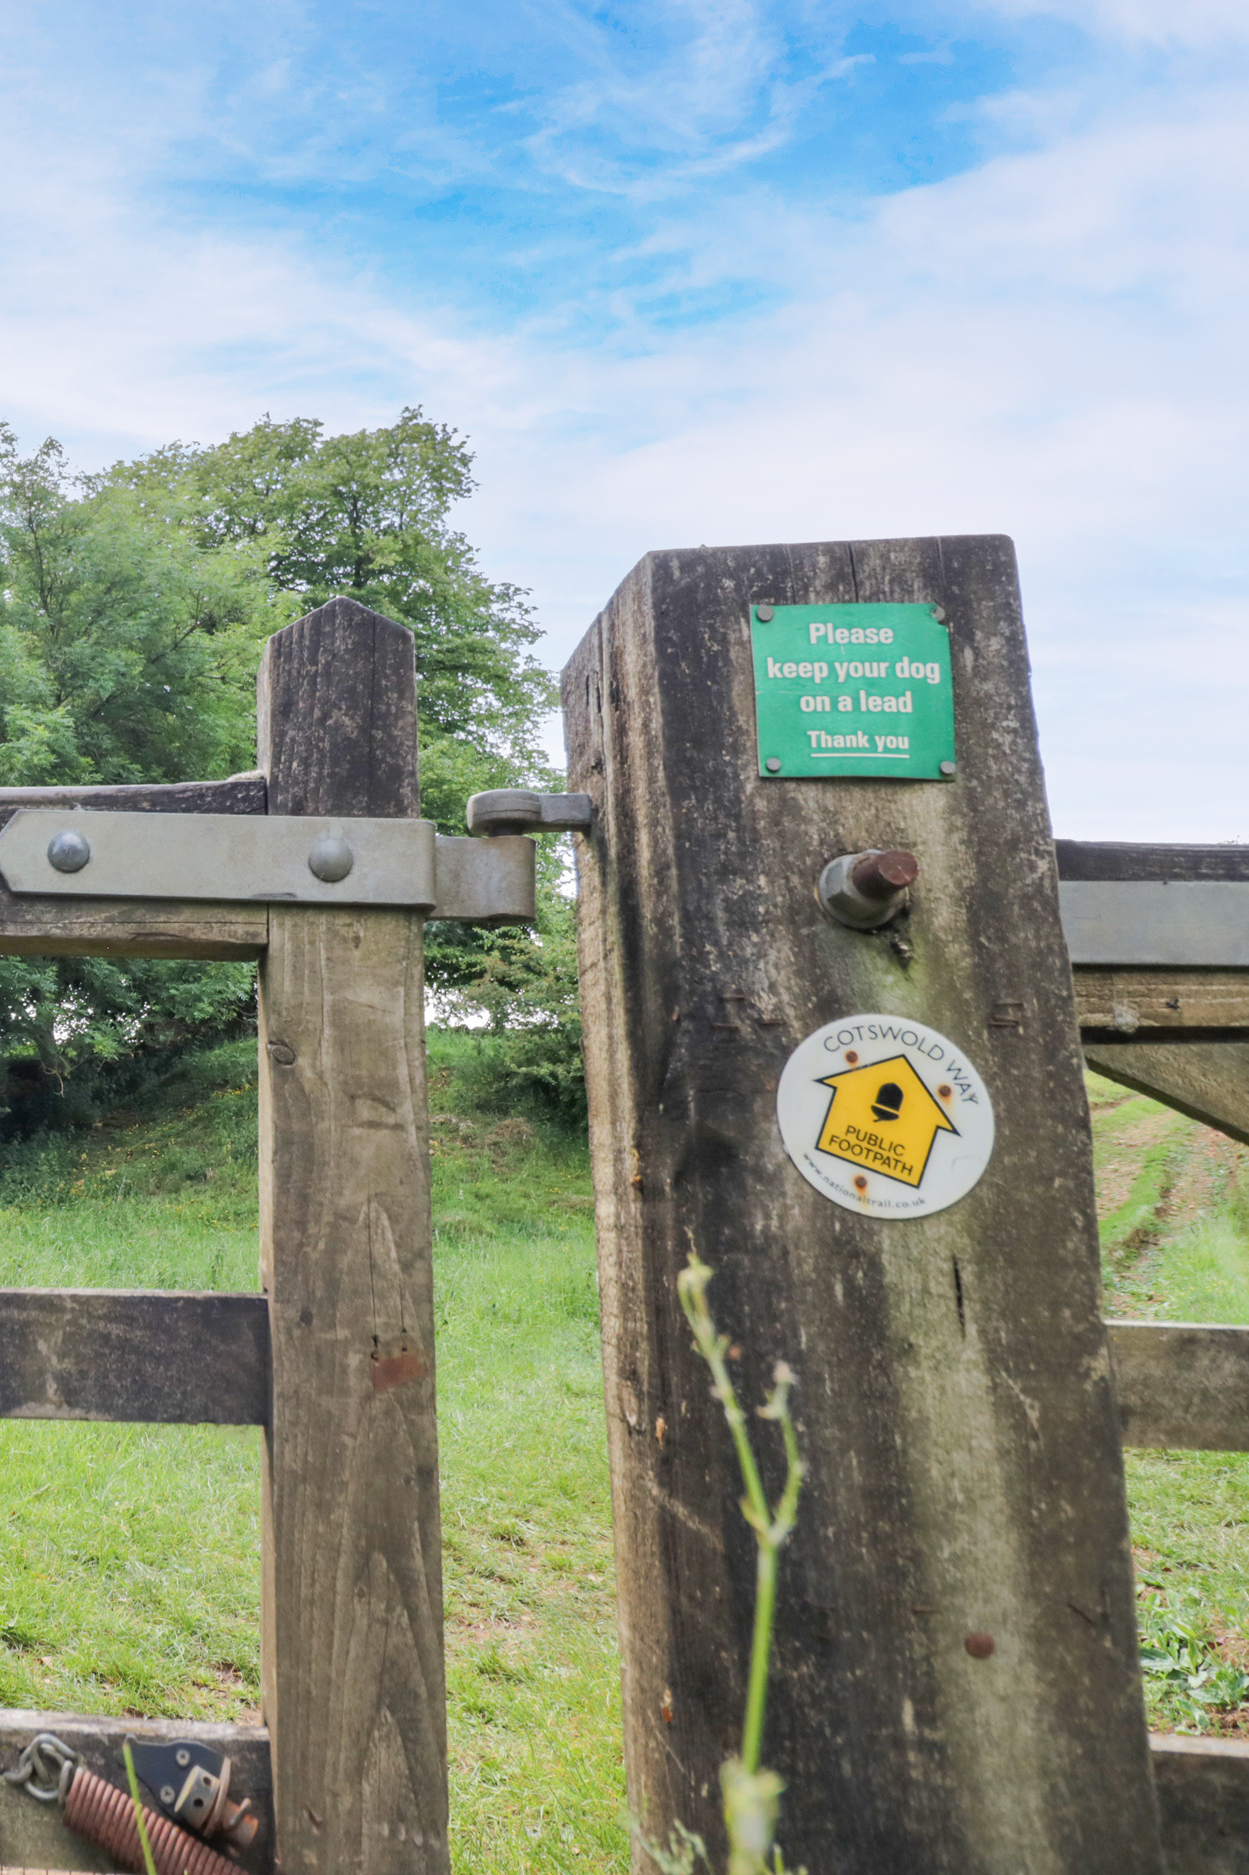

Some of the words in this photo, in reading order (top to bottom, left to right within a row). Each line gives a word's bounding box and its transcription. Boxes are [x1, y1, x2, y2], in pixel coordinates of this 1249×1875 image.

[809, 622, 894, 645] Please
[766, 657, 829, 684] keep
[834, 661, 890, 684] your
[895, 656, 941, 685] dog
[799, 695, 831, 713] on
[837, 695, 853, 712] a
[859, 690, 913, 713] lead
[806, 730, 870, 749] Thank
[874, 735, 910, 753] you
[823, 1024, 945, 1061] COTSWOLD
[946, 1060, 980, 1106] WAY
[828, 1135, 914, 1176] FOOTPATH
[845, 1125, 906, 1157] PUBLIC
